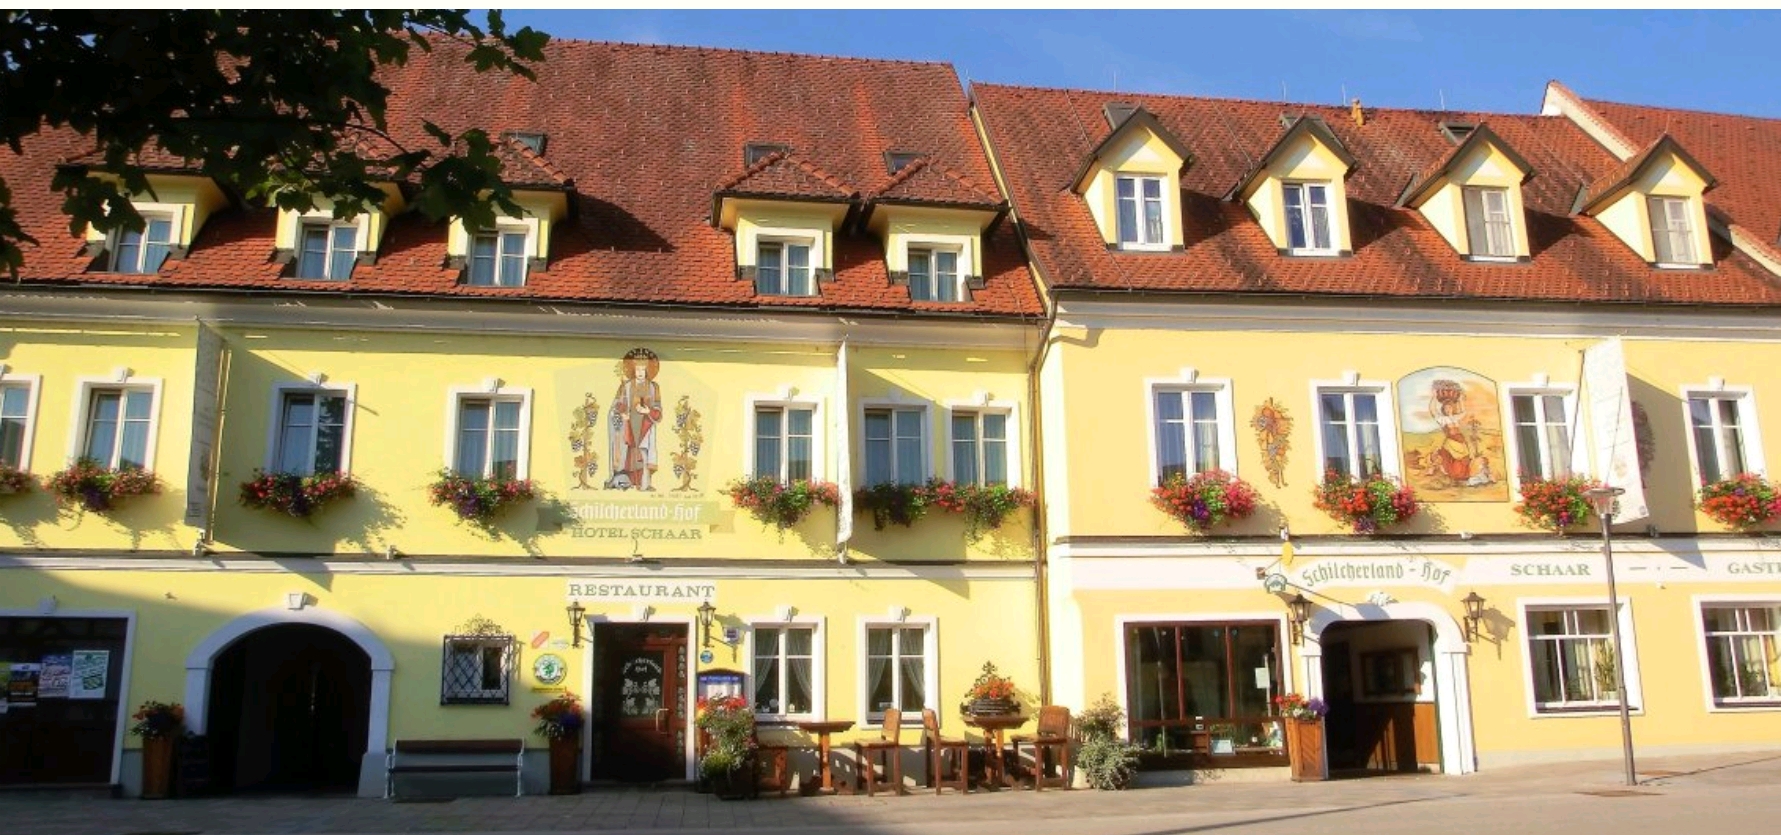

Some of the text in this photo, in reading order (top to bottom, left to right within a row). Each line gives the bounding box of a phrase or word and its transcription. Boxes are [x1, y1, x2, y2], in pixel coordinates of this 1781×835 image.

[571, 527, 702, 540] HOTEL SCHAAR
[1302, 562, 1403, 587] Schilcherland
[1421, 561, 1451, 585] Hof
[1510, 563, 1591, 576] SCHAAR
[568, 584, 716, 598] RESTAURANT
